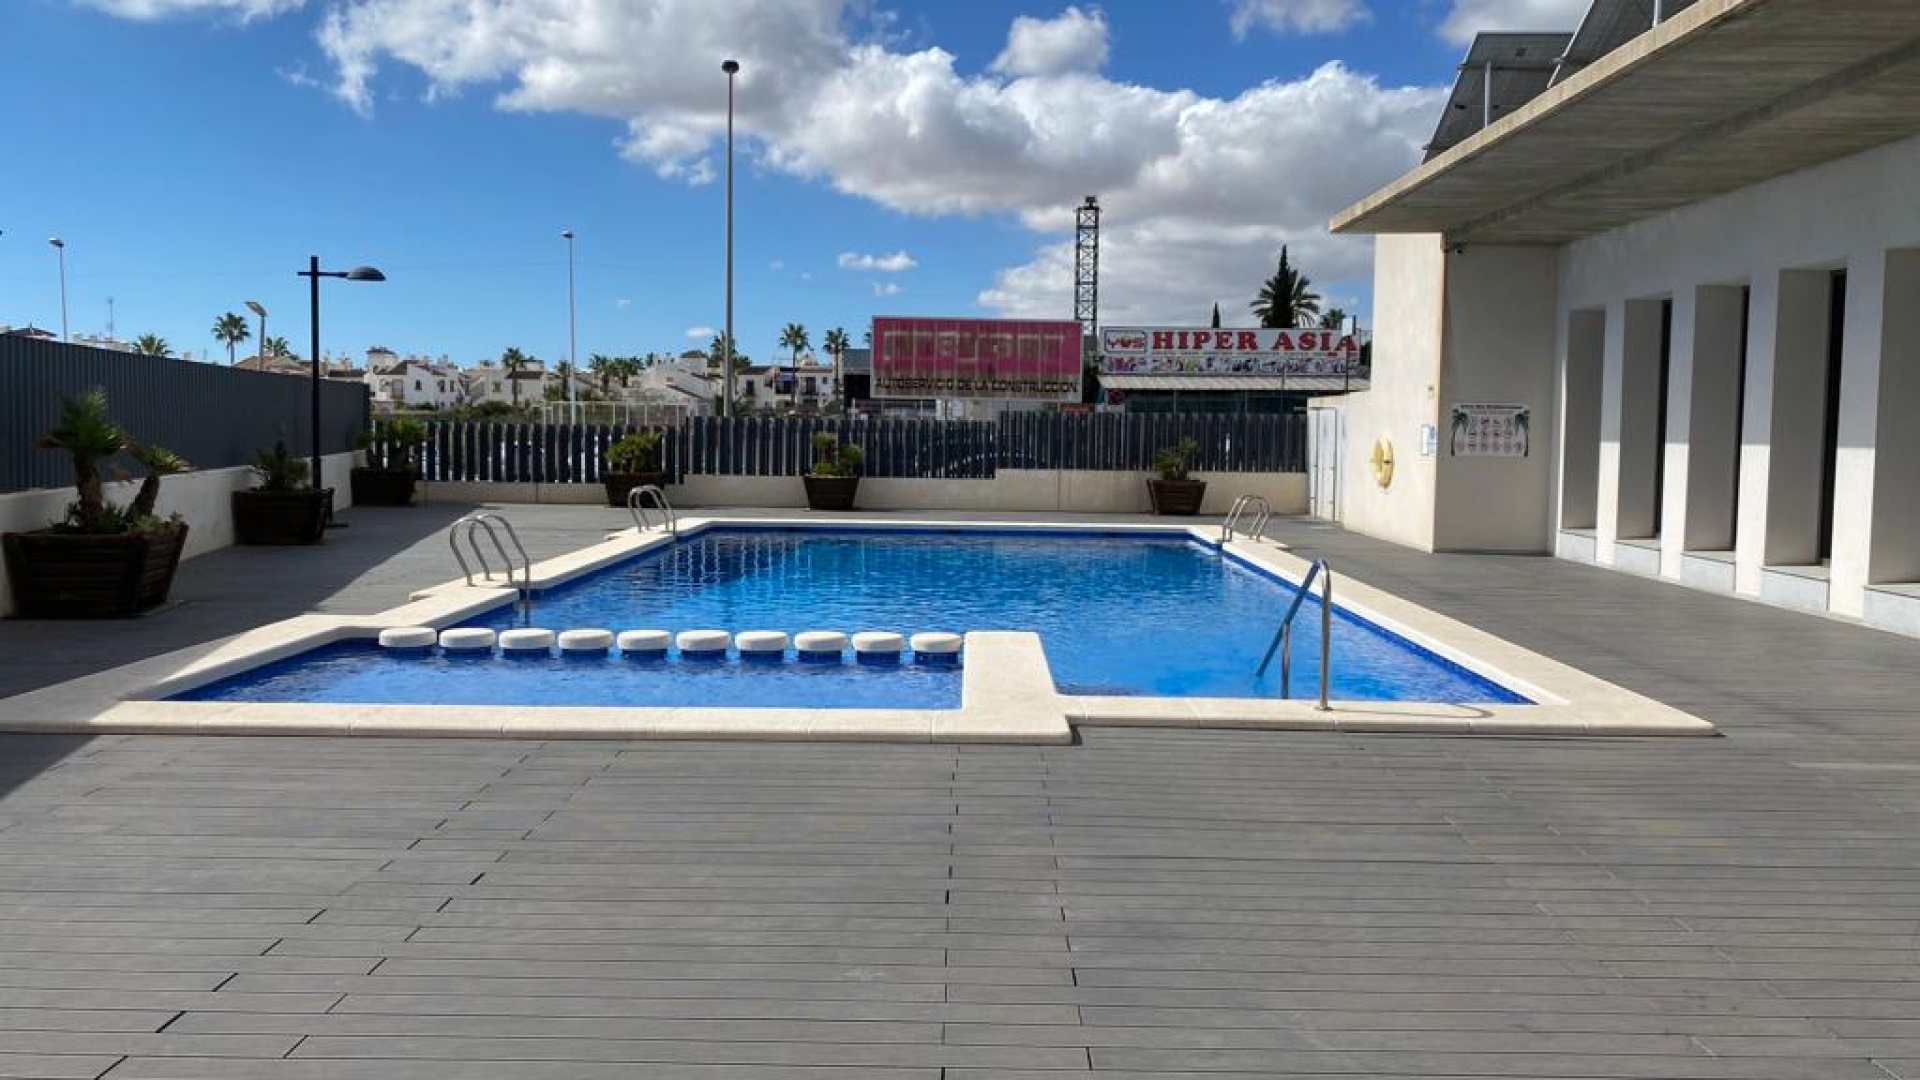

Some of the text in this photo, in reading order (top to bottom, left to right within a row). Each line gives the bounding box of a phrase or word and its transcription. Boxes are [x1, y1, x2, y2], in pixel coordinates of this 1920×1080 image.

[1152, 331, 1357, 351] HIPER ASIA
[875, 377, 954, 390] AUTOSERVICIO
[957, 379, 972, 391] DE
[975, 379, 989, 391] LA
